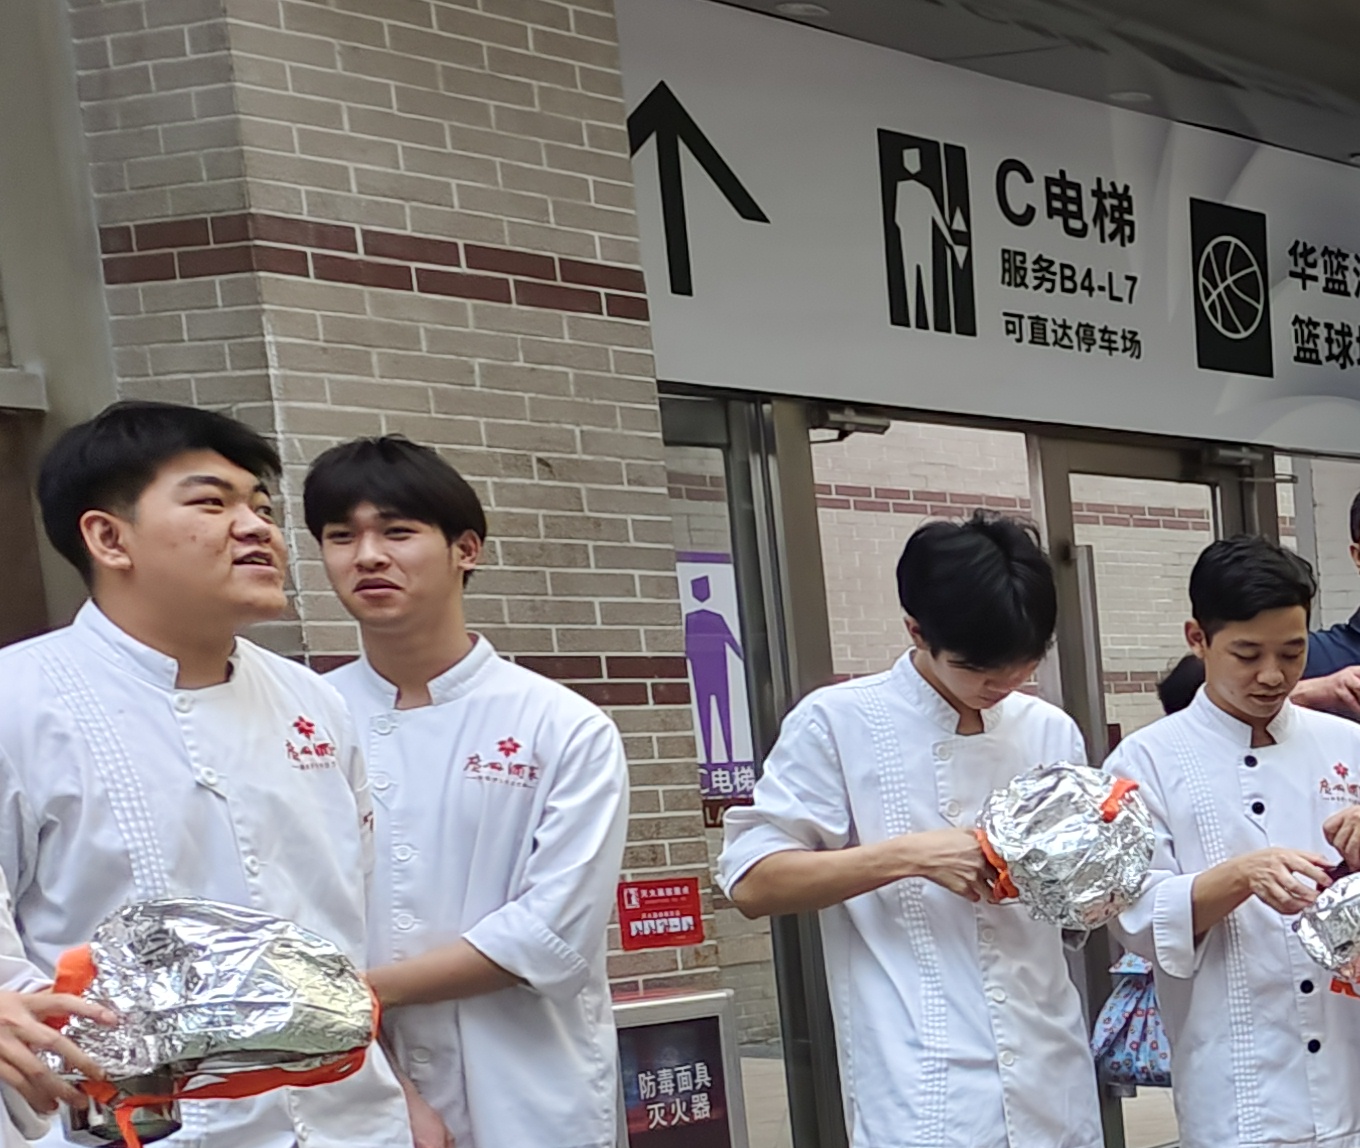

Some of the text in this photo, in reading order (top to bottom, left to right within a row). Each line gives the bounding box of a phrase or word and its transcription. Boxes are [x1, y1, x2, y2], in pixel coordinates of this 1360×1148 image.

[996, 158, 1136, 248] C电梯
[1001, 248, 1138, 305] 服务B4-L7
[1002, 311, 1143, 360] 可直达停车场
[638, 1062, 712, 1100] 防毒面具
[646, 1092, 711, 1129] 灭火器
